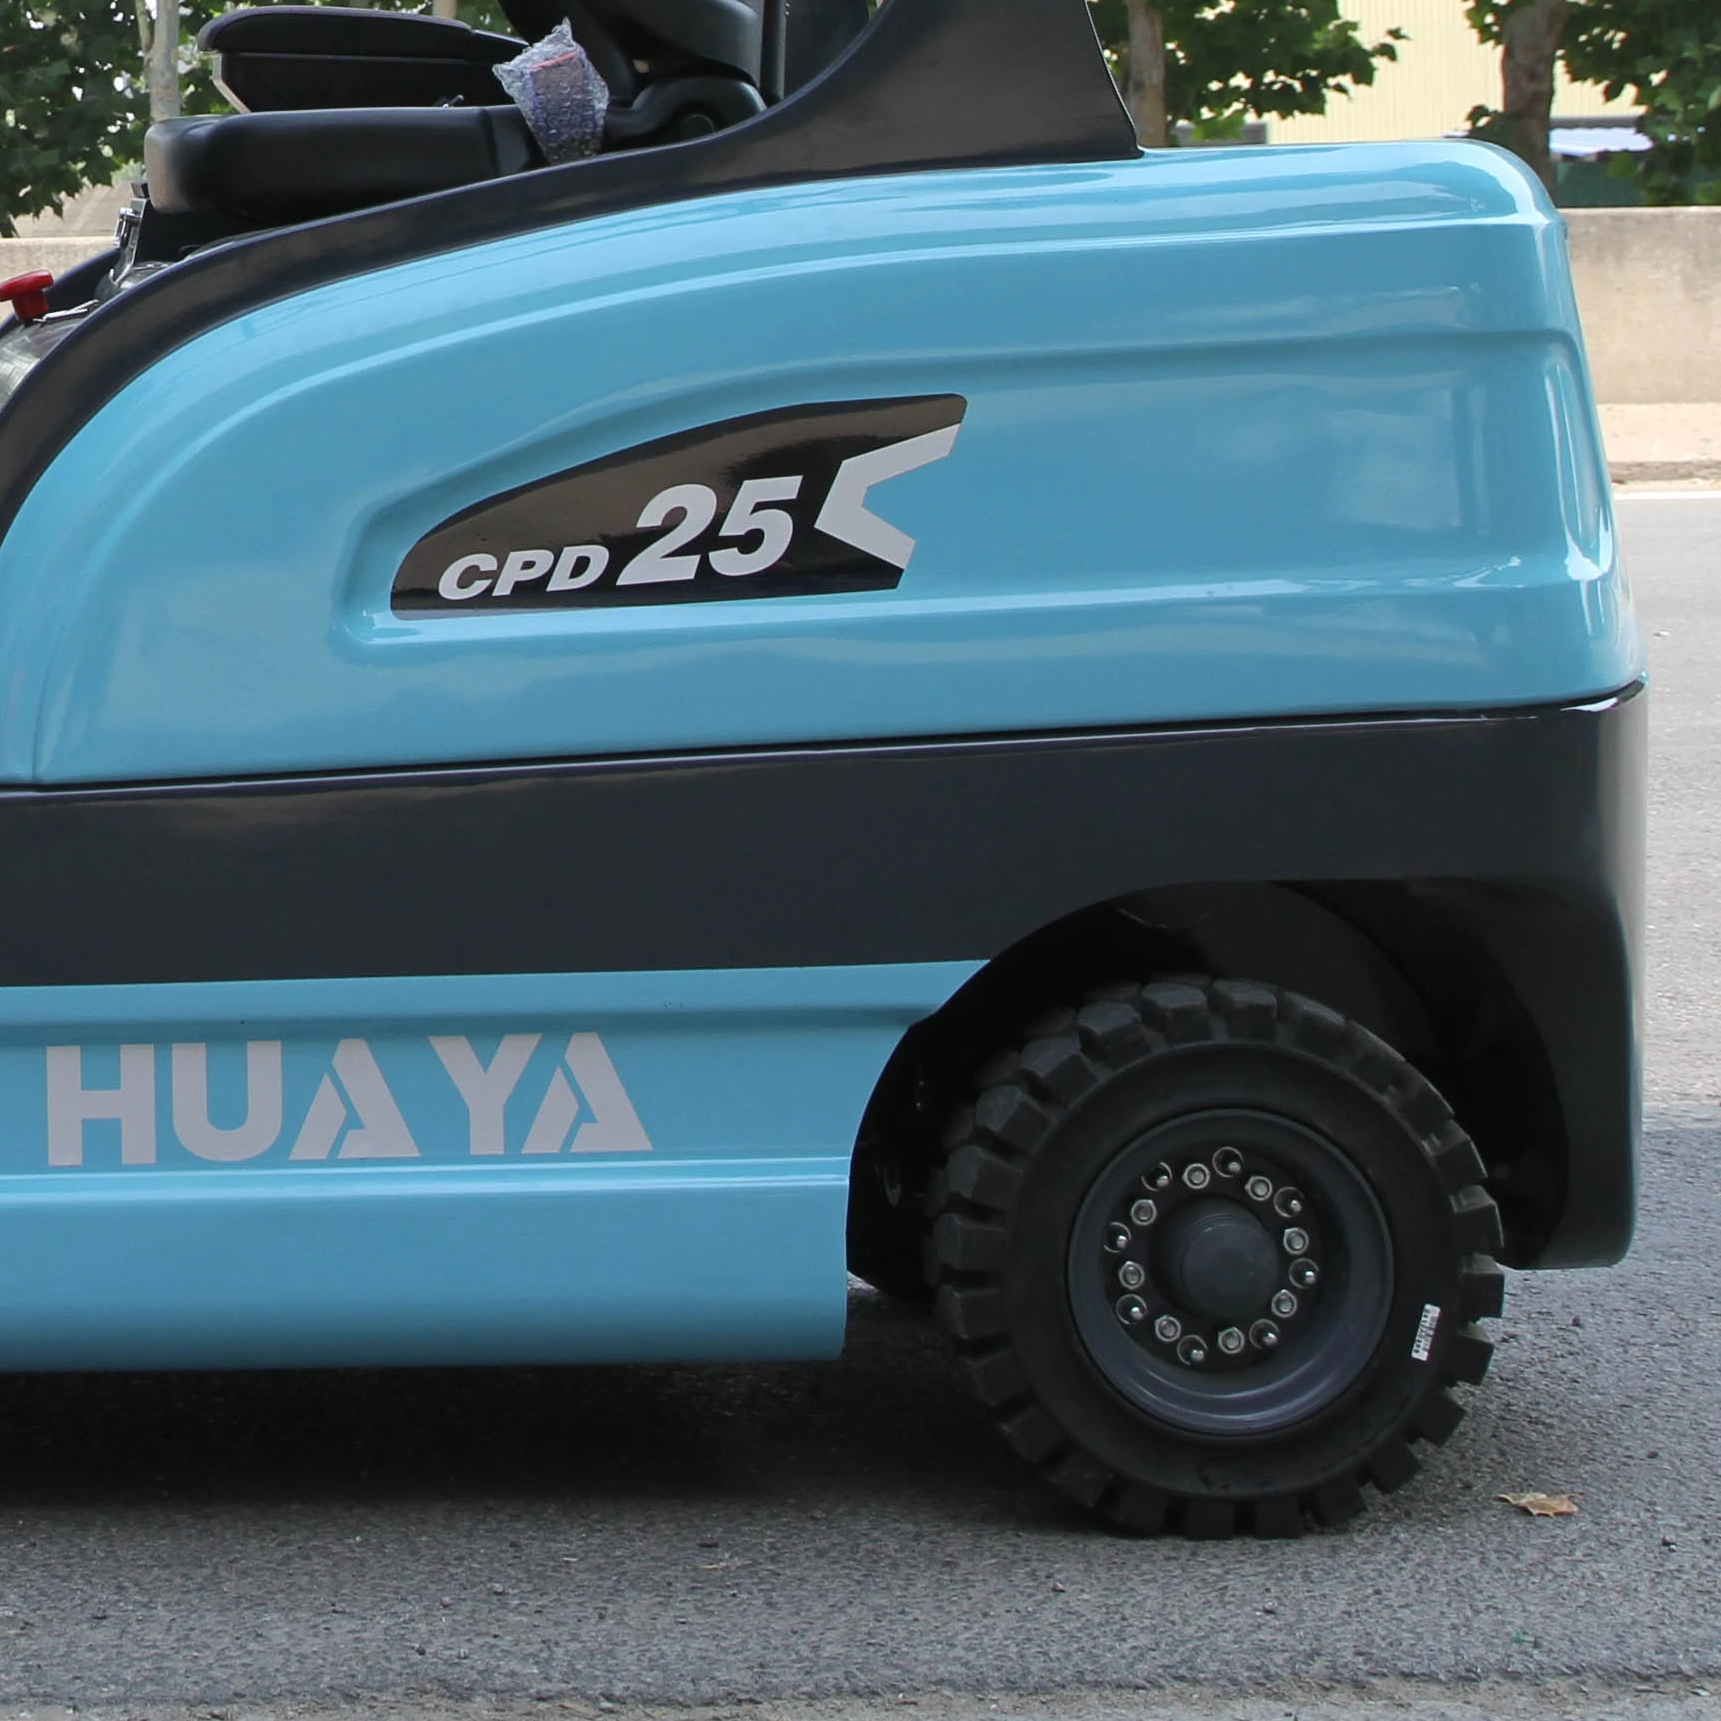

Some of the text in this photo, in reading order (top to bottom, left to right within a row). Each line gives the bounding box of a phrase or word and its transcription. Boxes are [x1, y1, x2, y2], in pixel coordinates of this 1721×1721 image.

[439, 476, 803, 600] CPD 25
[46, 1032, 654, 1166] HUAYA
